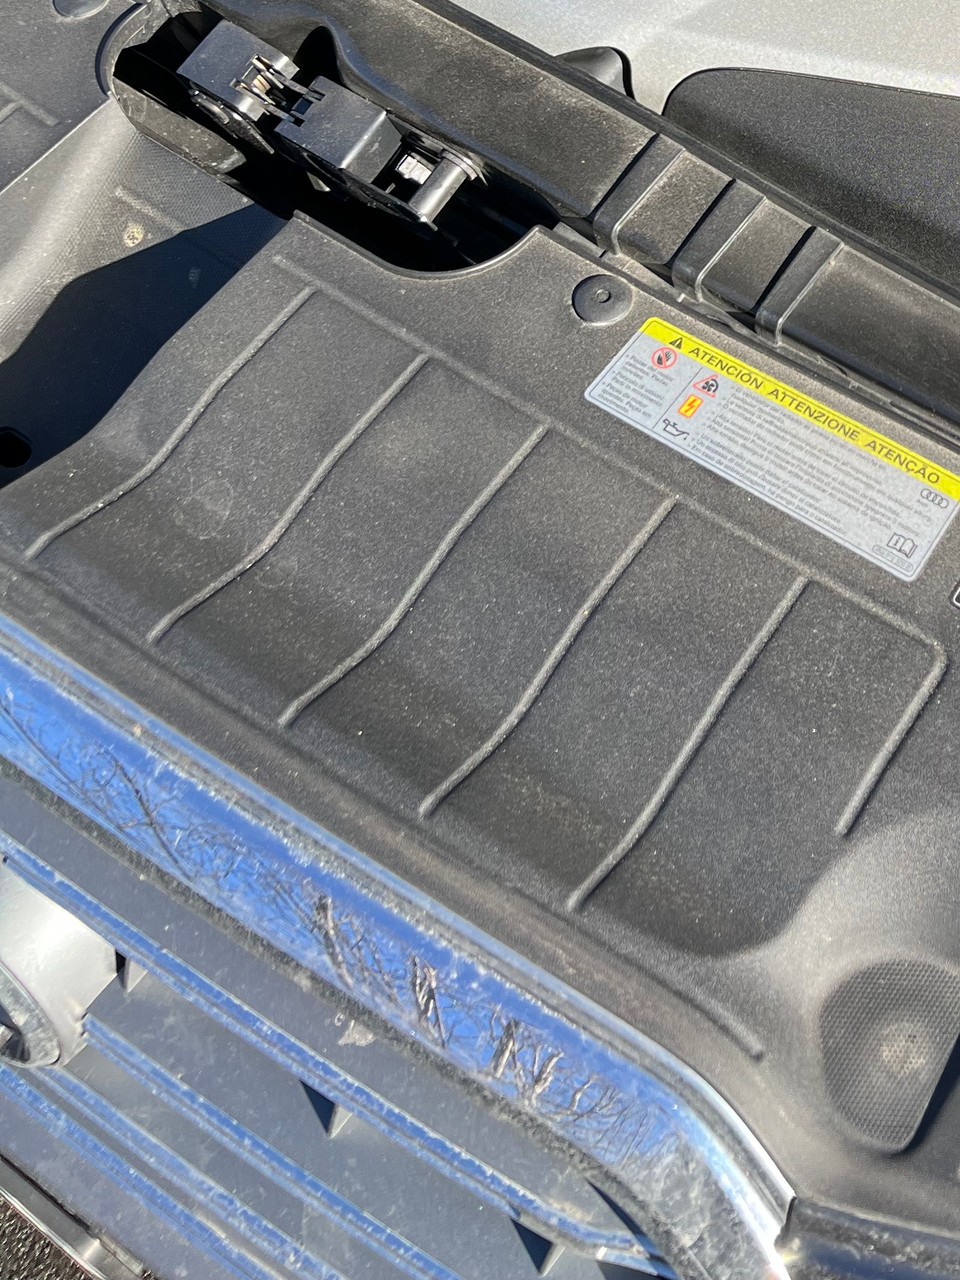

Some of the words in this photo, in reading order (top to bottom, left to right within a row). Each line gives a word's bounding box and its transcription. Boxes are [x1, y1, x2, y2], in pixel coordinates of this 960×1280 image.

[688, 345, 763, 390] ATENCIÓN
[768, 387, 860, 441] ATTENZIONE
[864, 439, 941, 485] ATENÇÃO
